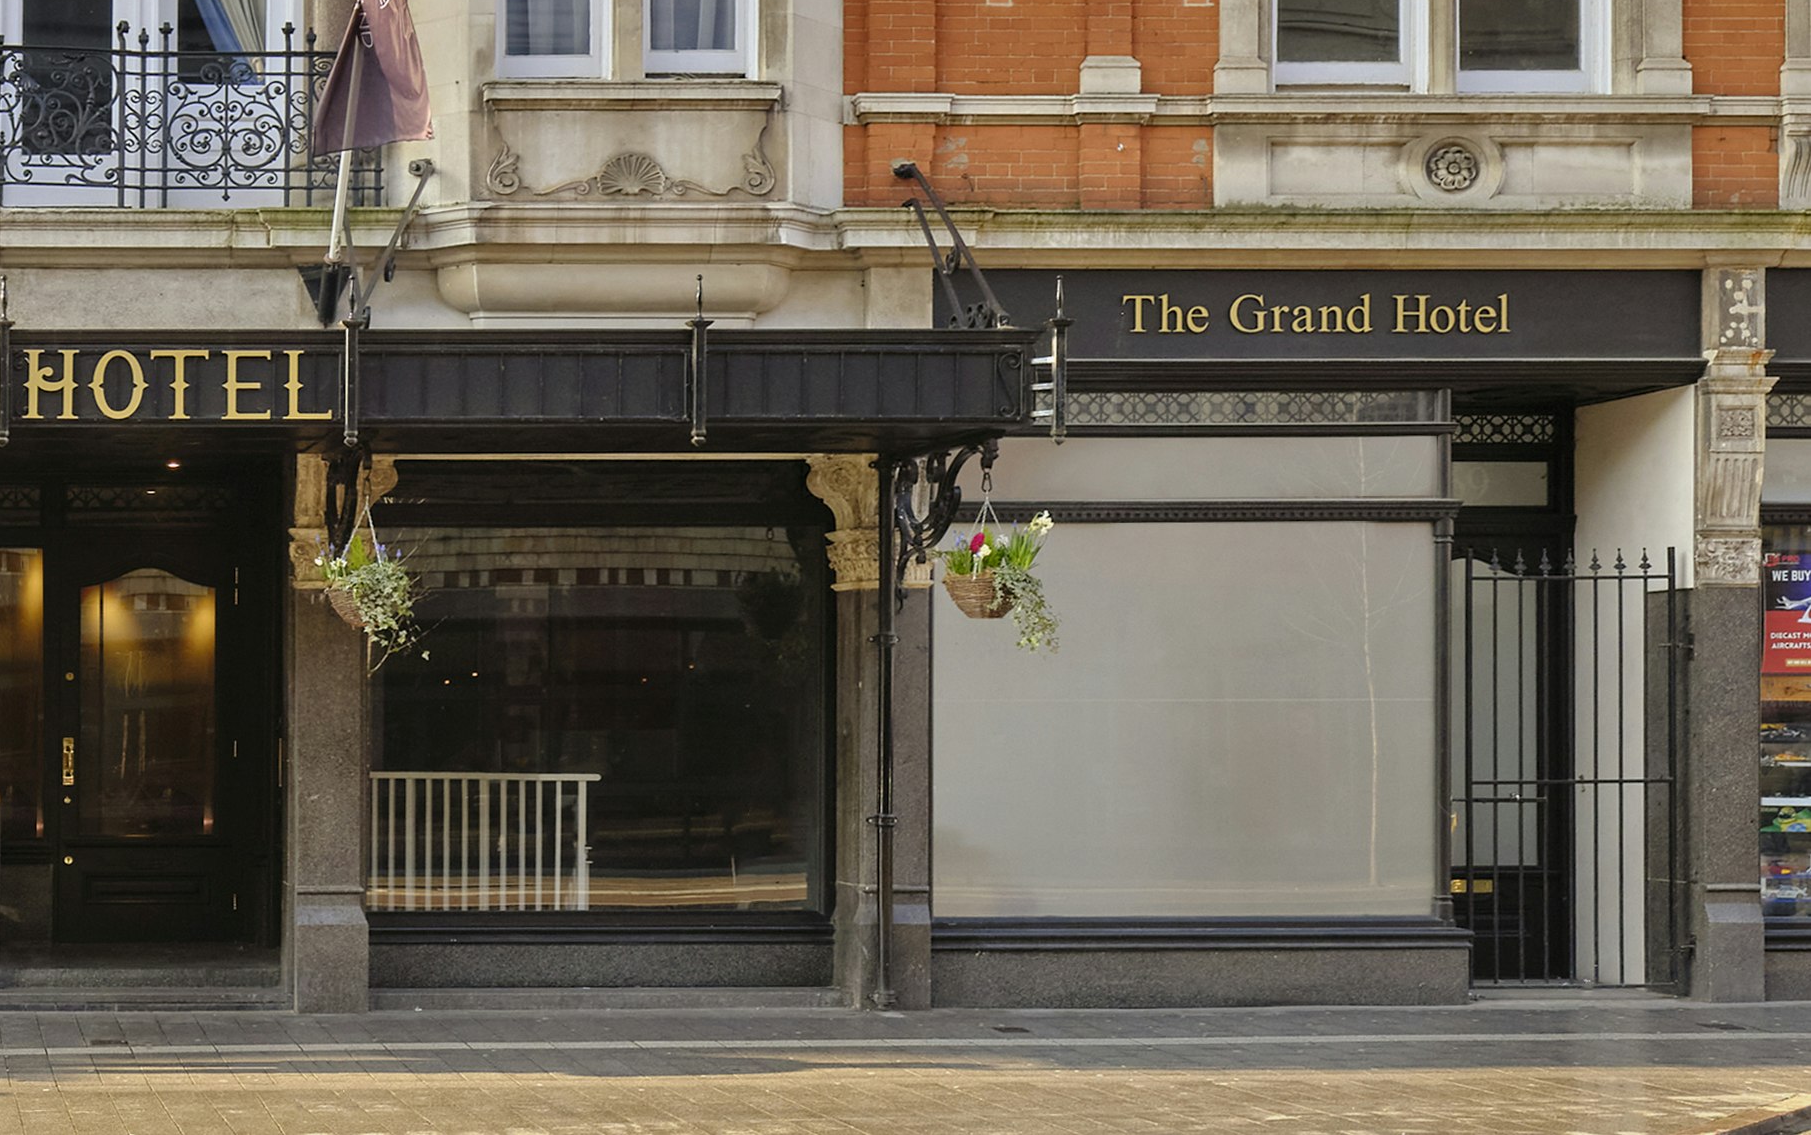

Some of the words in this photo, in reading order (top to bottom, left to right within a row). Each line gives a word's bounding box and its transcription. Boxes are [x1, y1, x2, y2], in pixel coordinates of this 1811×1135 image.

[1122, 293, 1209, 333] The
[1229, 293, 1372, 334] Grand
[1391, 293, 1510, 334] Hotel
[22, 349, 332, 421] HOTEL
[1772, 570, 1789, 581] WE
[1791, 570, 1811, 581] BUY
